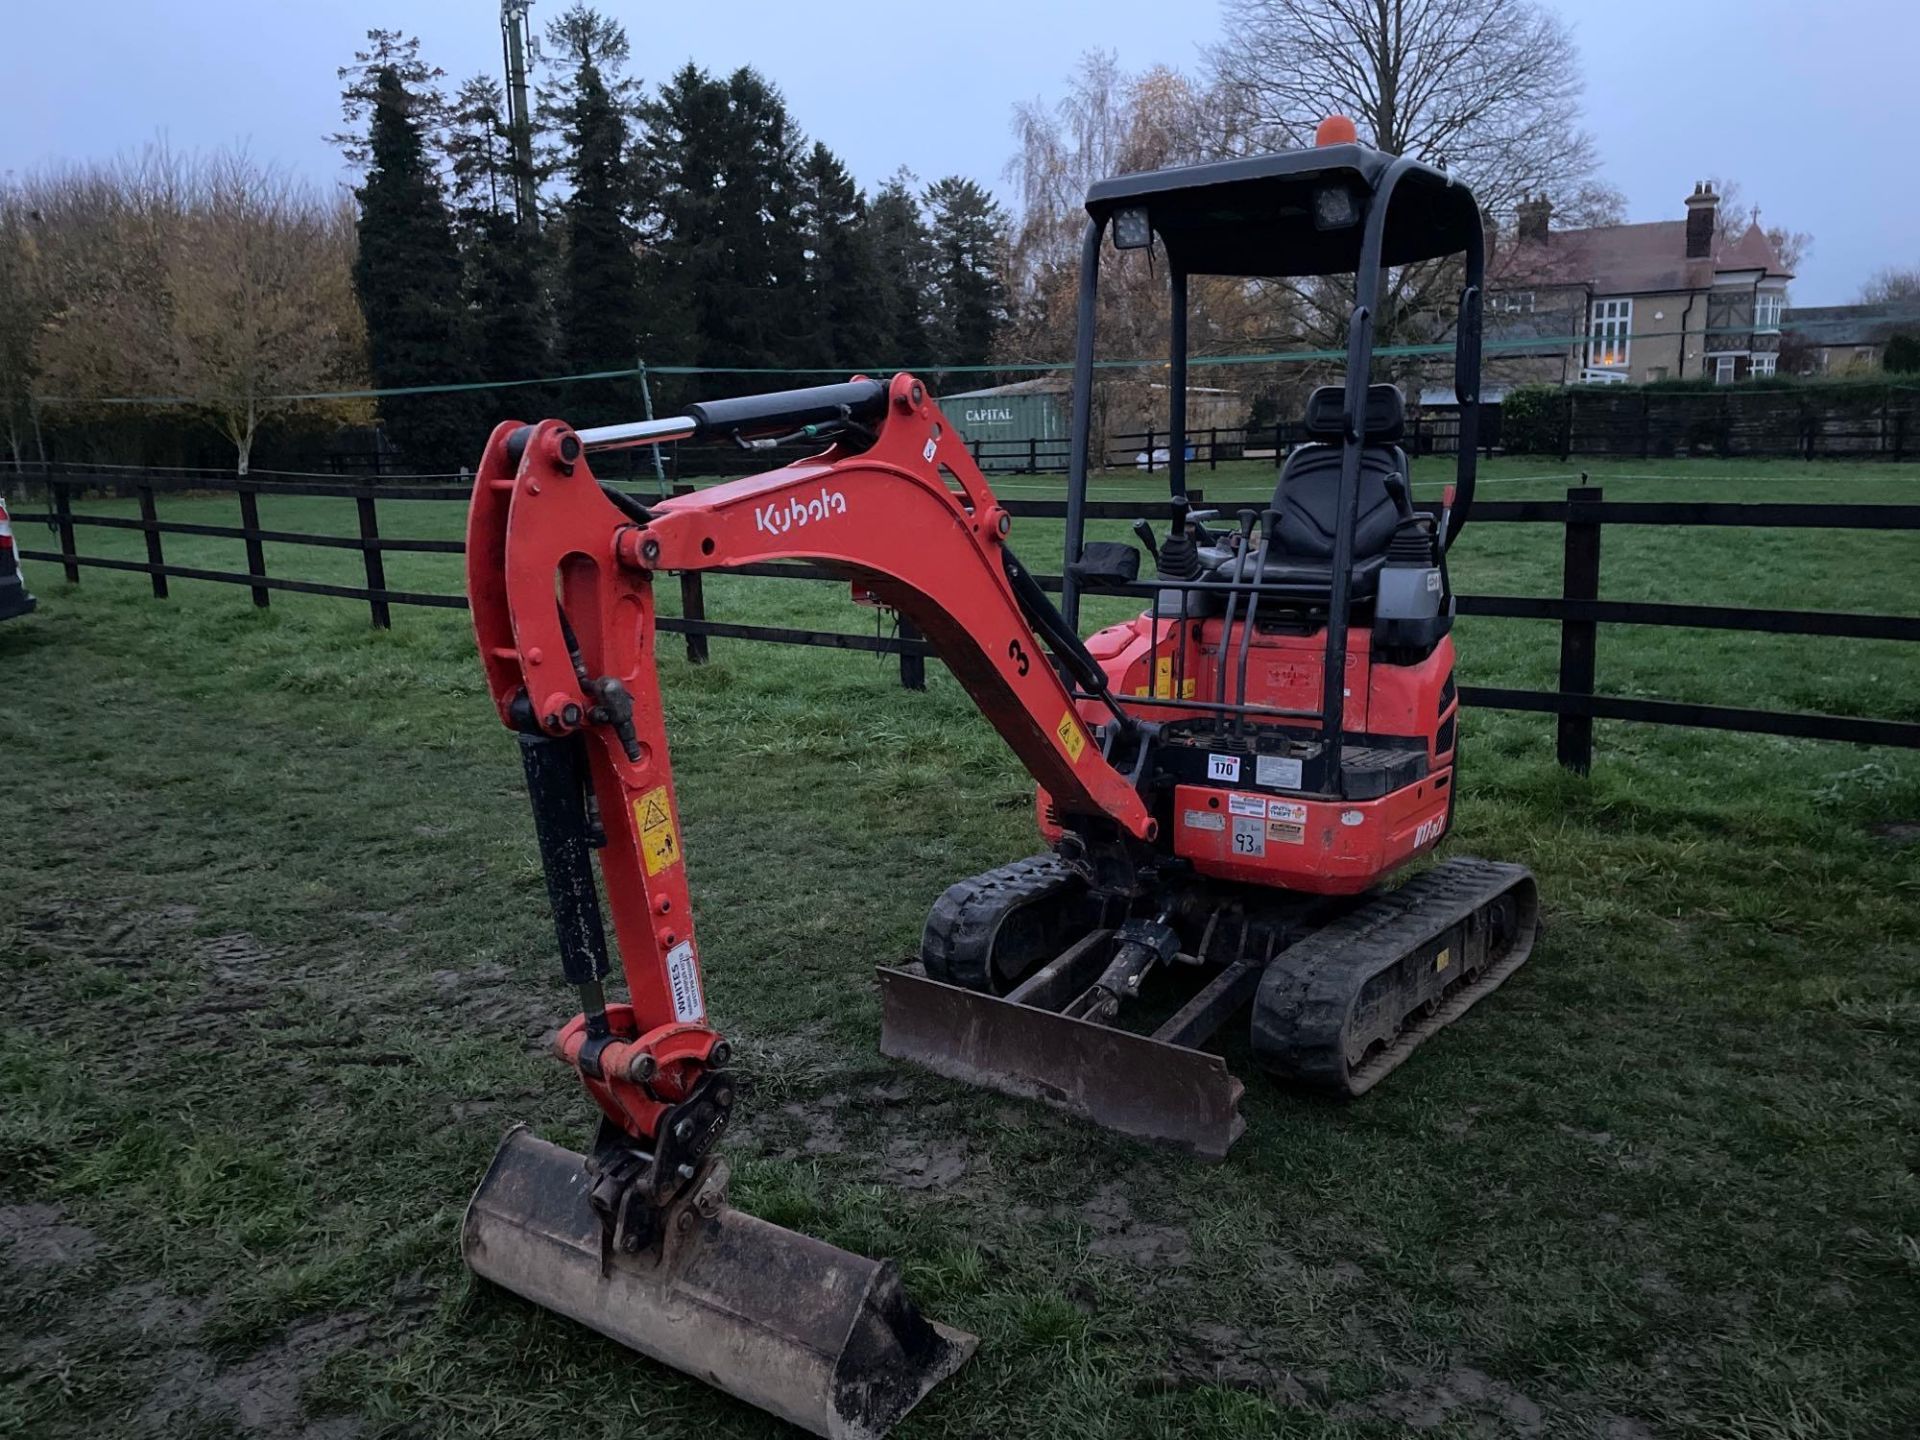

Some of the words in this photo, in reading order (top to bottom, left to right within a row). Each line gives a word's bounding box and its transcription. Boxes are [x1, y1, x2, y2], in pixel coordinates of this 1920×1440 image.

[966, 408, 1014, 421] CAPITAL
[755, 488, 847, 535] Kubota
[1009, 639, 1029, 677] 3
[1215, 762, 1233, 776] 170
[1236, 833, 1254, 853] 93
[671, 964, 686, 1014] WHITES
